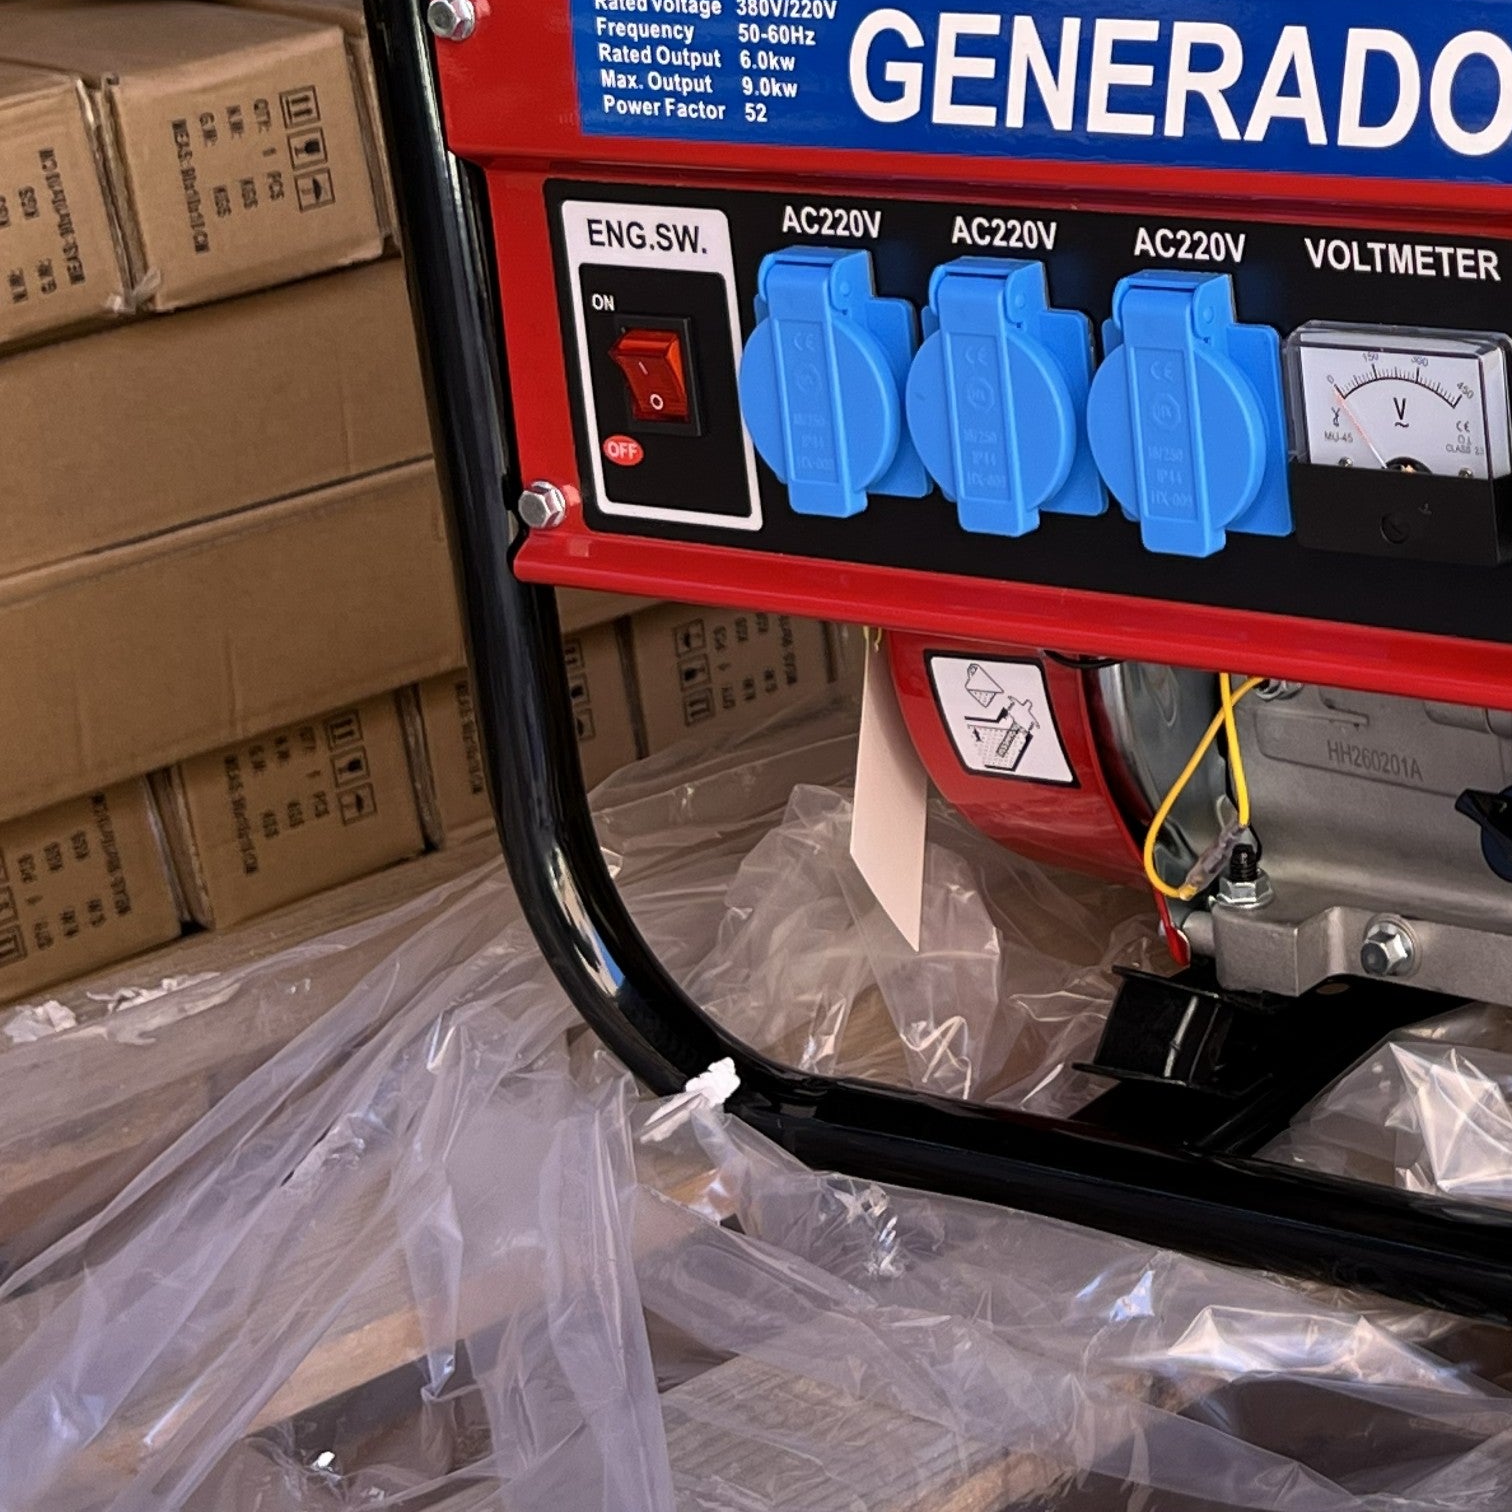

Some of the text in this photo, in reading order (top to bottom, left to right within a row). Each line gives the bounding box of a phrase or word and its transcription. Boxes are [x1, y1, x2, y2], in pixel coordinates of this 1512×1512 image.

[596, 17, 816, 46] Frequency 50-60Hz
[598, 42, 795, 72] Rated Output 6.0kw
[600, 69, 798, 98] Max. Output 9.0kw
[603, 94, 768, 123] Power Factor 52
[586, 218, 708, 254] ENG.SW.
[782, 205, 882, 239] AC220V
[951, 215, 1058, 250] AC220V
[1133, 227, 1246, 263] AC220V
[1303, 237, 1501, 282] VOLTMETER
[592, 294, 614, 312] ON
[1393, 397, 1407, 420] V
[606, 440, 638, 459] OFF
[1327, 739, 1424, 782] HH260201A
